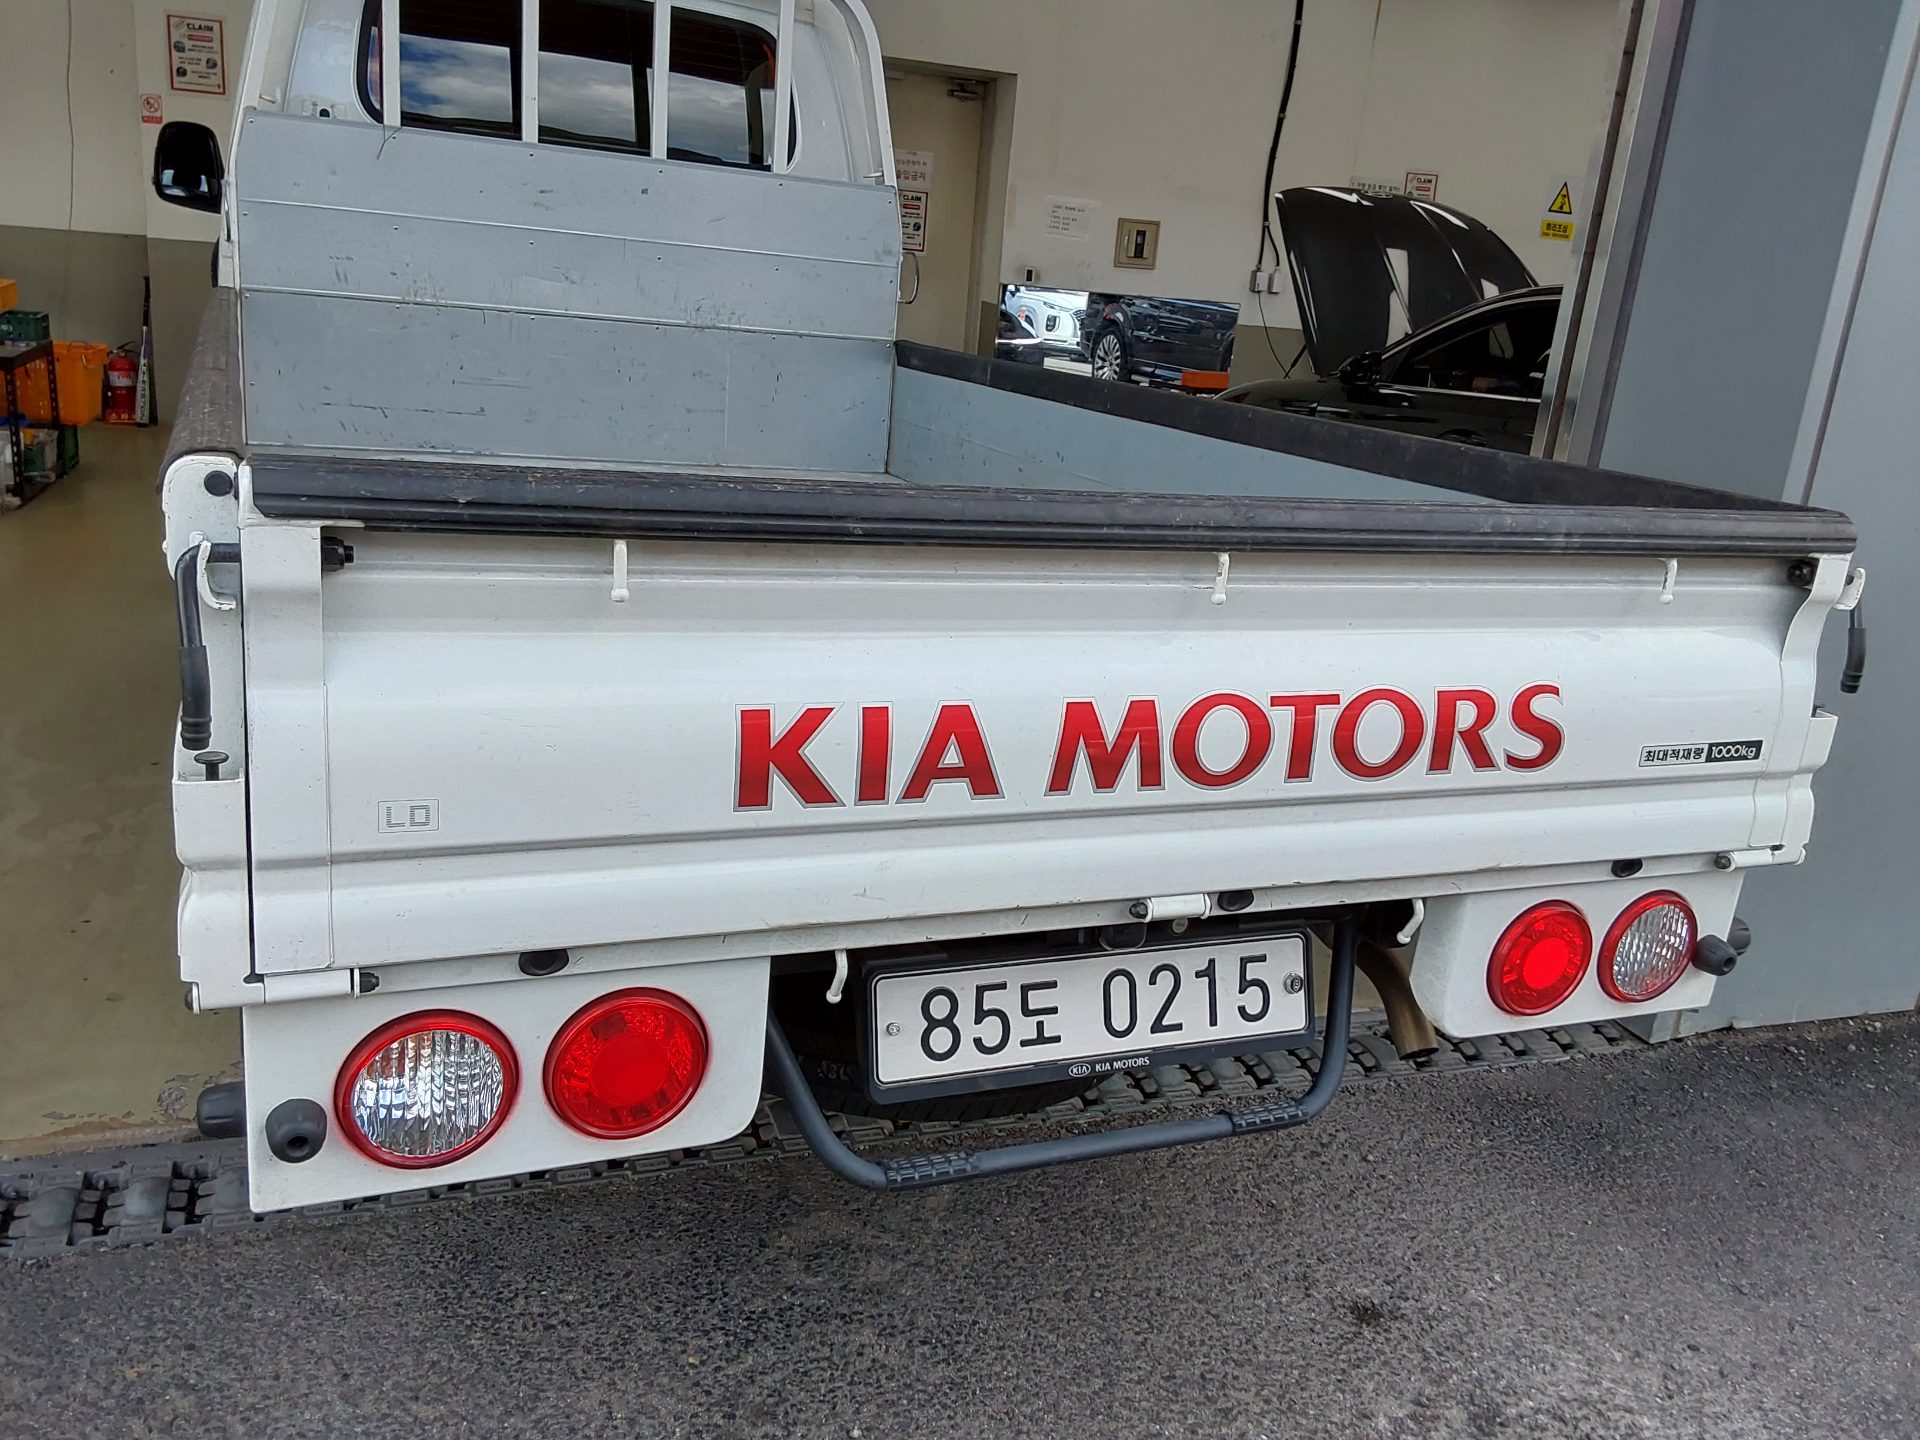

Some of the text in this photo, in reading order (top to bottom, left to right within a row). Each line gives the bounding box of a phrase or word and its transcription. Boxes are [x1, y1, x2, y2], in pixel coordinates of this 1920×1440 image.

[186, 22, 214, 32] CLAIM
[734, 683, 1565, 811] KIA MOTORS
[1643, 744, 1756, 762] 최대적재량 1000kg
[920, 952, 1272, 1062] 85도 0215
[1071, 1056, 1150, 1075] KIA KIA MOTORS
